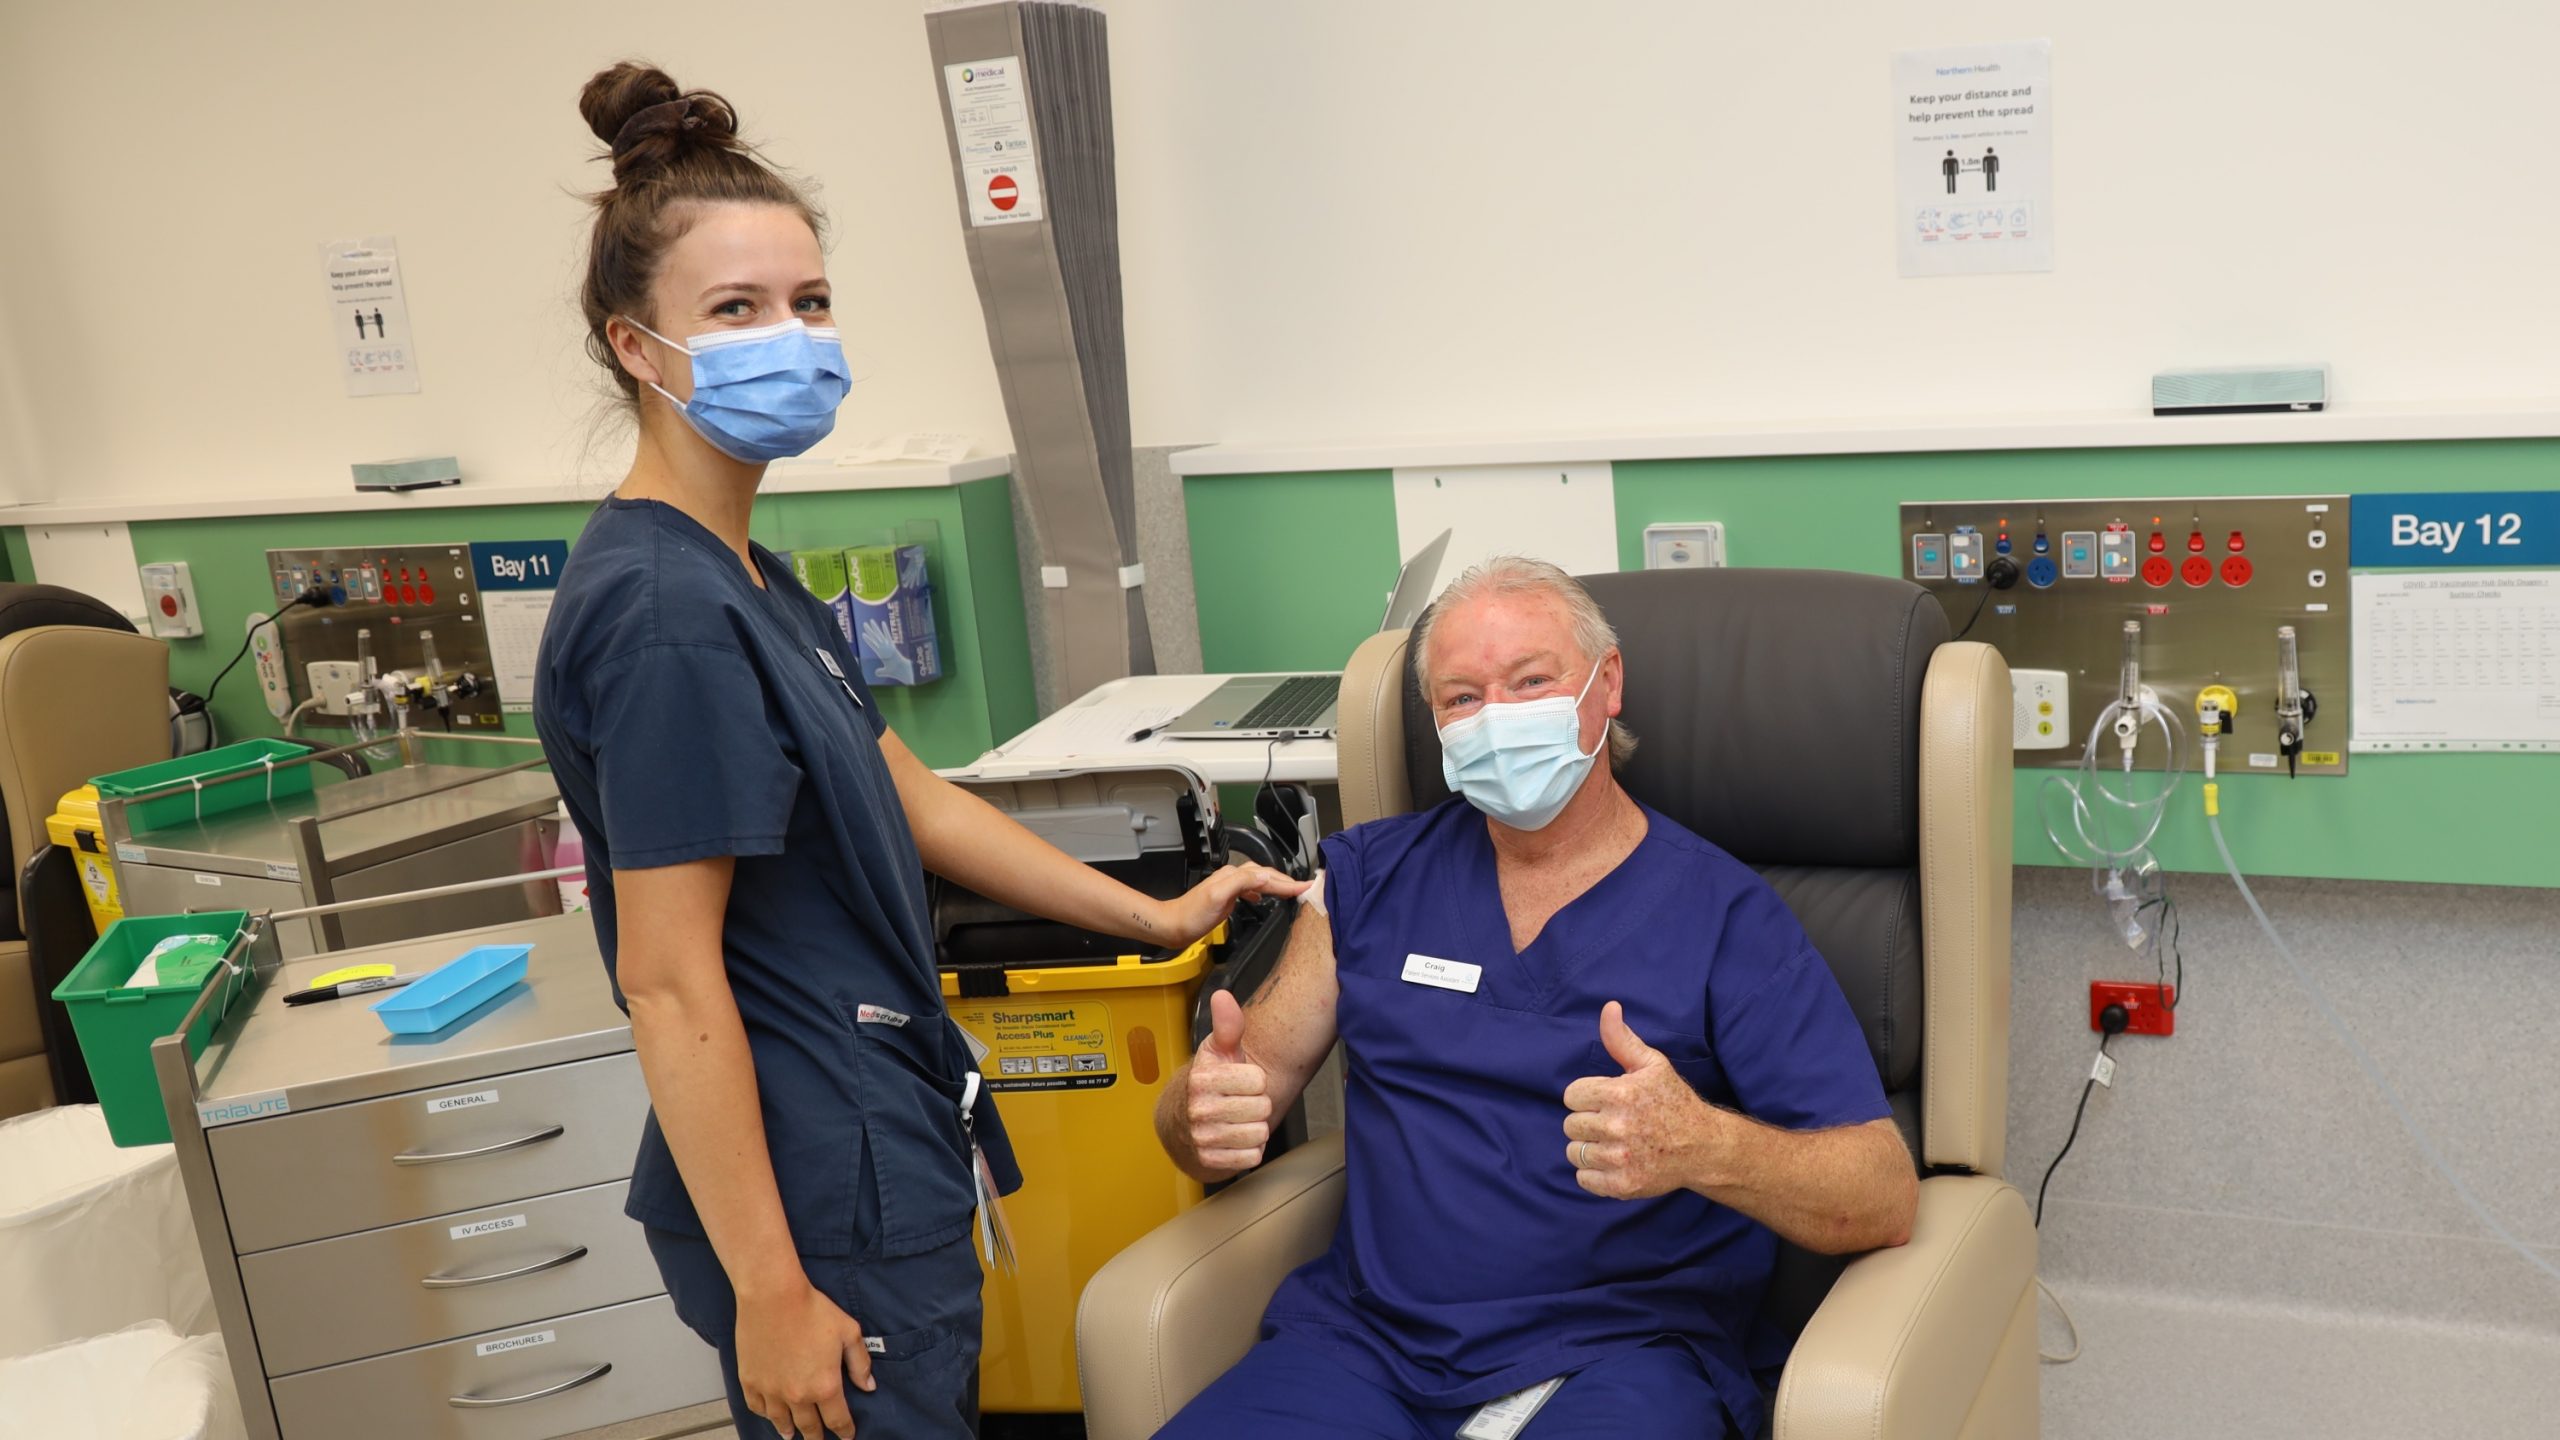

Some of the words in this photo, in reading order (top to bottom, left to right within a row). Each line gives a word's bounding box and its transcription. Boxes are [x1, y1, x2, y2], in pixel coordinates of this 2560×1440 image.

[1974, 64, 2001, 73] Health
[1910, 94, 1936, 104] Keep
[1938, 92, 1962, 104] your
[1965, 89, 2008, 100] distance
[2011, 86, 2032, 96] and
[1908, 112, 1932, 124] help
[1934, 110, 1974, 122] prevent
[1977, 108, 1995, 118] the
[1998, 104, 2034, 118] spread
[2391, 513, 2465, 554] Bay
[2475, 513, 2523, 546] 12
[491, 555, 526, 581] Bay
[529, 554, 550, 576] 11
[850, 556, 863, 593] qube
[887, 602, 899, 644] NITRILE
[916, 646, 926, 677] qube
[1424, 961, 1446, 972] Craig
[860, 1009, 903, 1024] Medscrubs
[992, 1010, 1075, 1024] Sharpsmart
[996, 1032, 1031, 1040] Access
[1033, 1030, 1054, 1039] Plus
[439, 1095, 487, 1109] GENERAL
[462, 1227, 472, 1235] IV
[474, 1219, 514, 1232] ACCESS
[486, 1334, 544, 1352] BROCHURES
